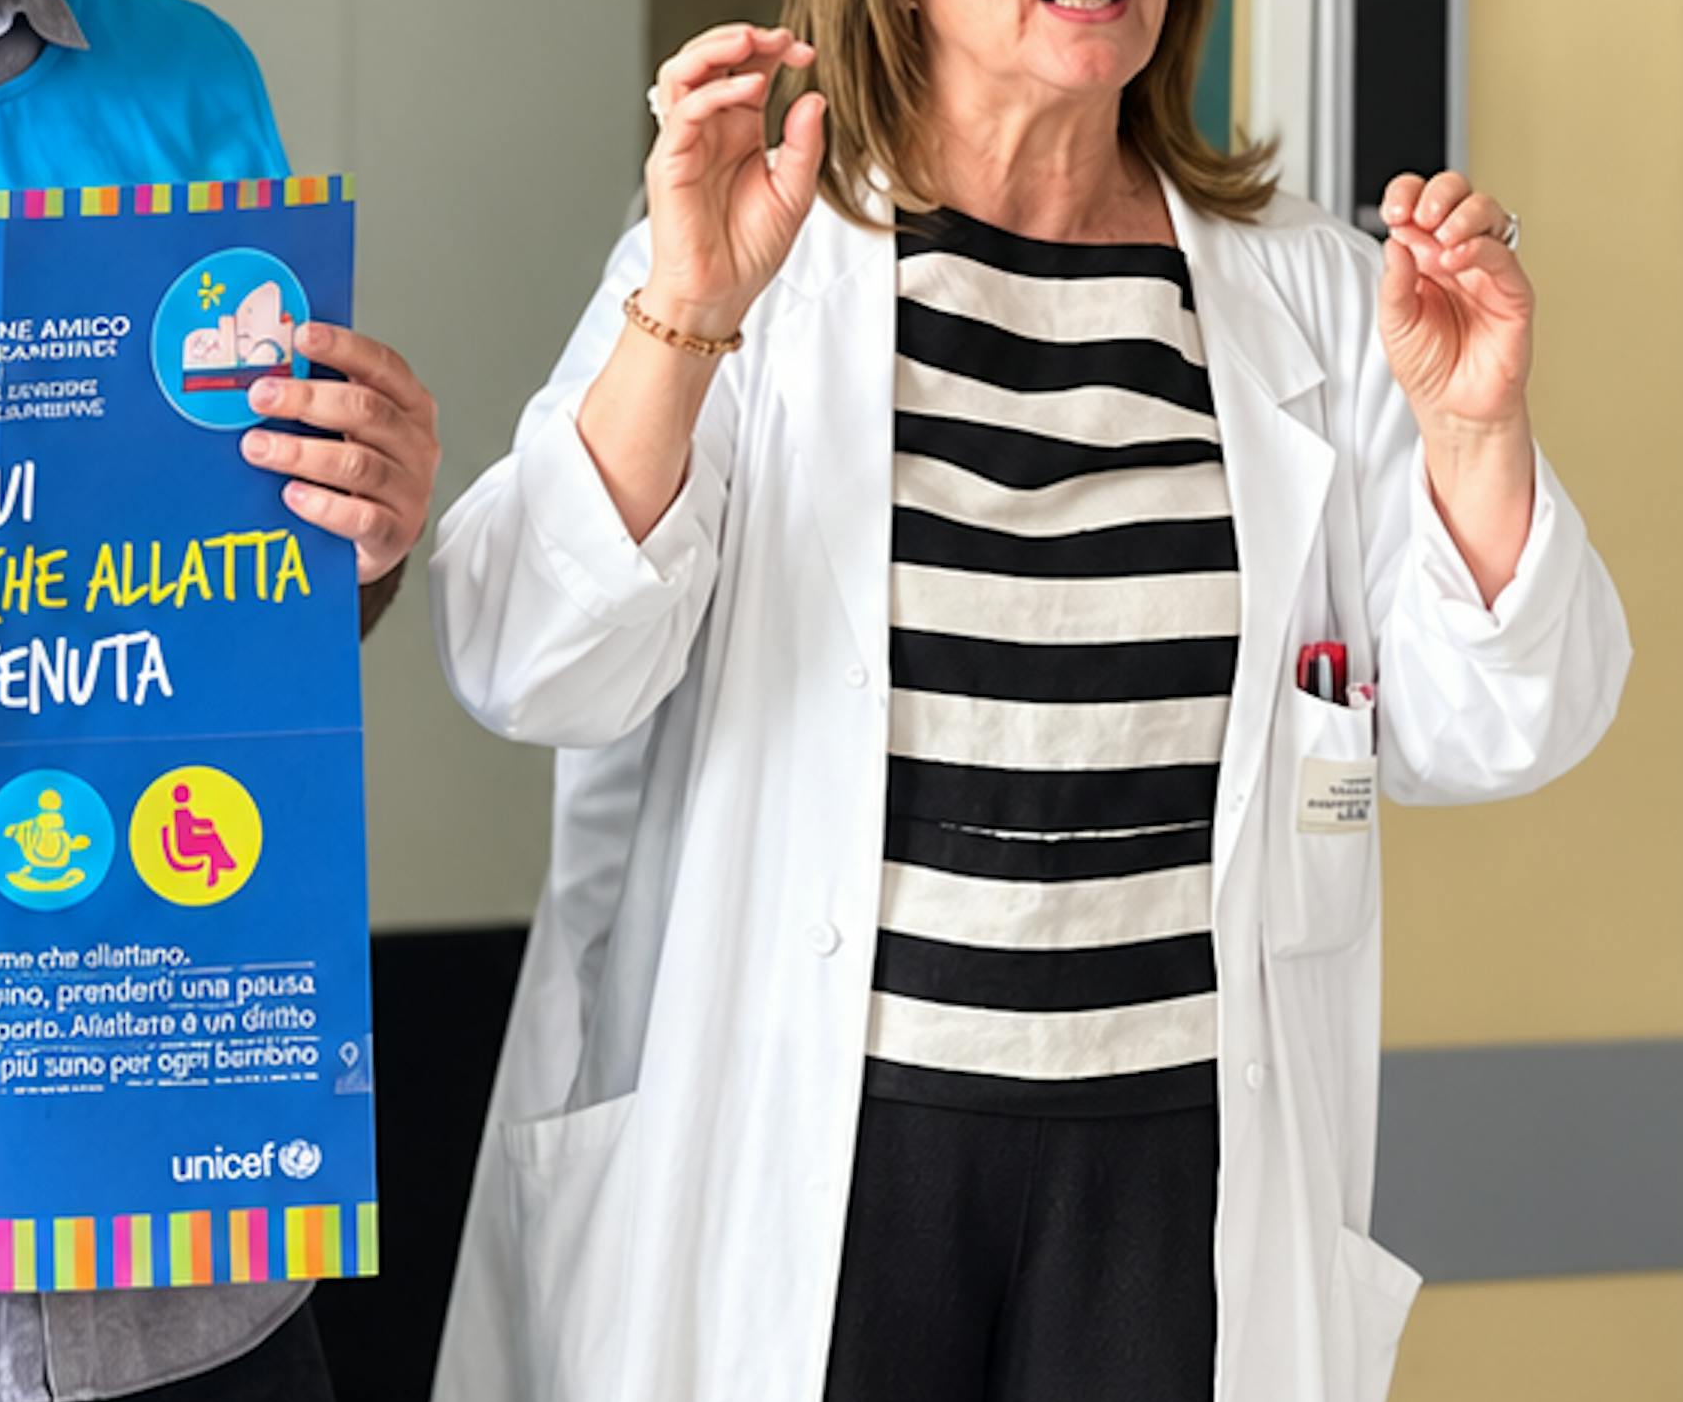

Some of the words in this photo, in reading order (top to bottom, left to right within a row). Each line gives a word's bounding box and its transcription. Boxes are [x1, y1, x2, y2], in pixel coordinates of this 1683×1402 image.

[40, 316, 131, 340] AMICO
[84, 529, 311, 613] ALLATTA
[172, 1141, 278, 1183] unicef
